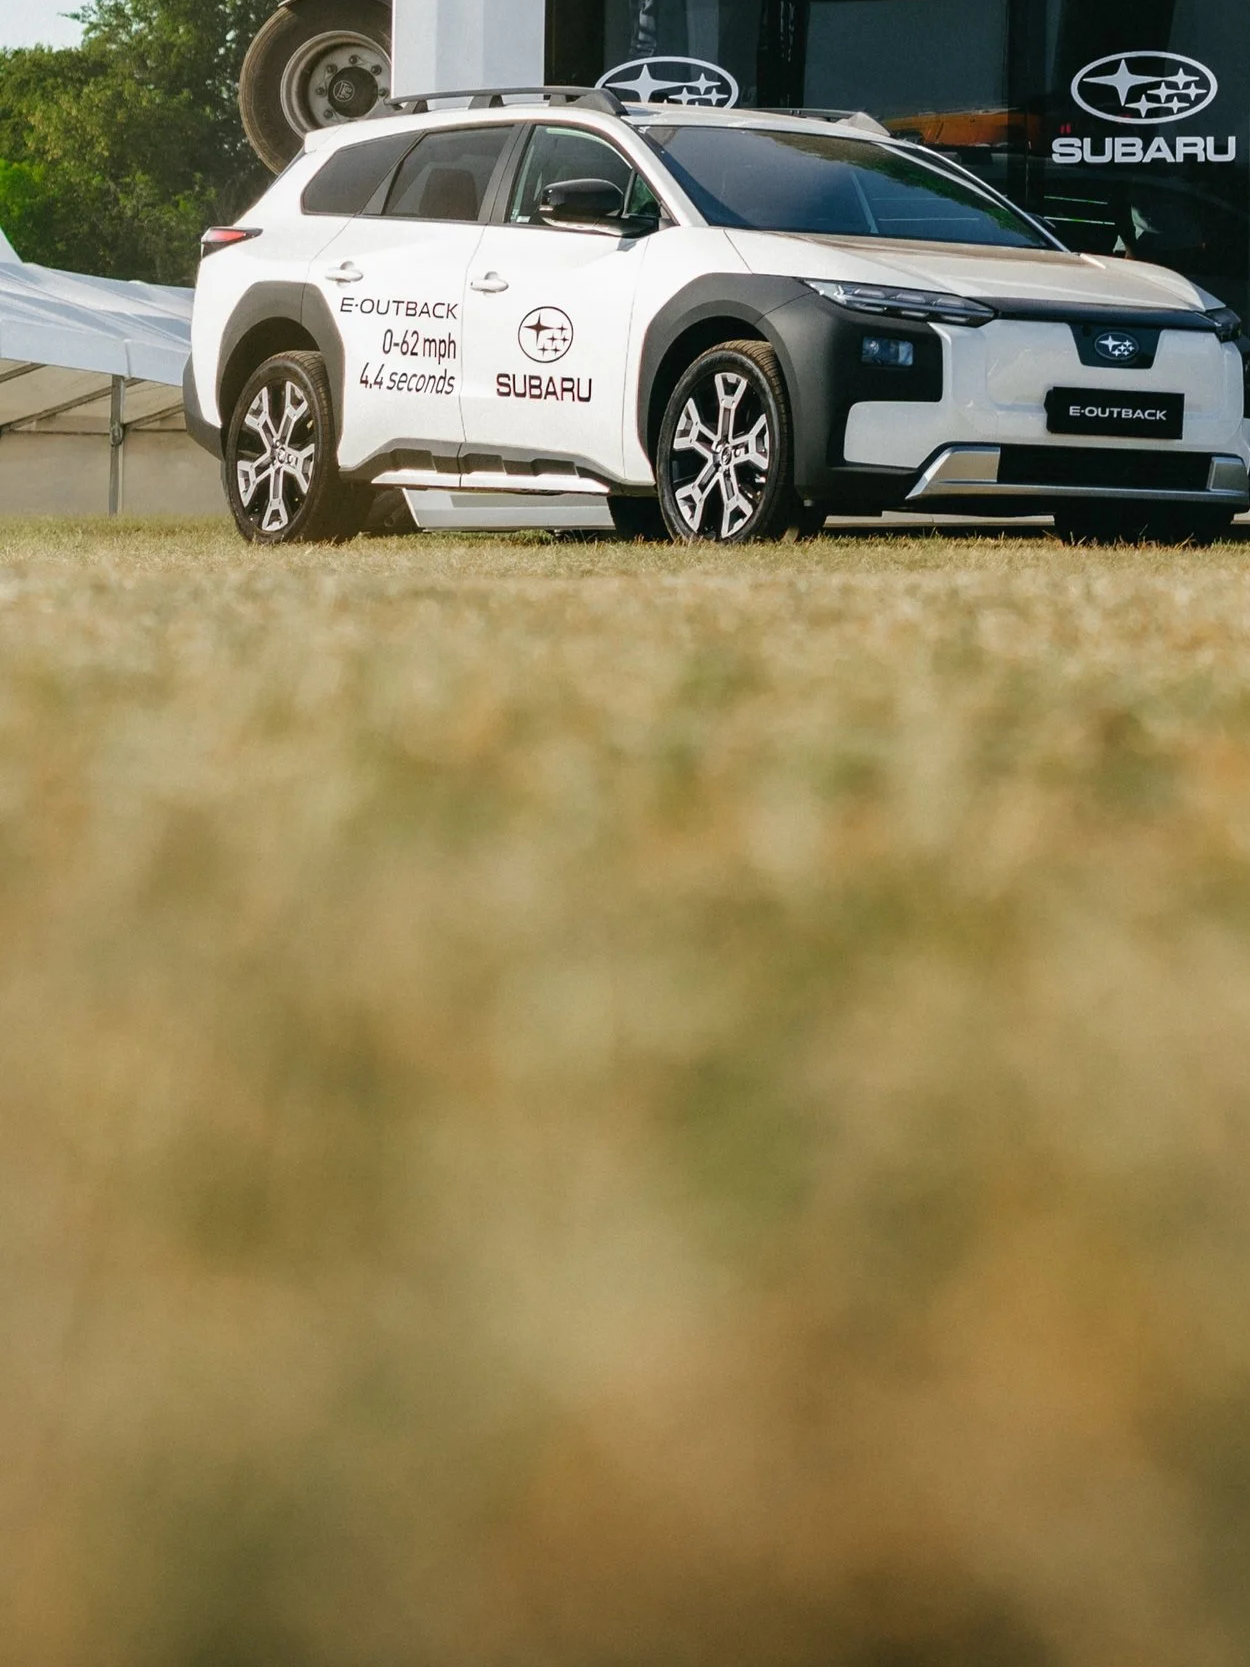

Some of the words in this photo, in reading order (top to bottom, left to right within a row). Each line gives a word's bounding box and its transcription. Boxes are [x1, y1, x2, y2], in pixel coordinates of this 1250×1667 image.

[1051, 135, 1237, 164] SUBARU
[340, 297, 458, 320] E-OUTBACK
[382, 328, 419, 357] 0-62
[422, 332, 457, 365] mph
[359, 362, 385, 390] 4.4
[386, 368, 456, 395] seconds
[496, 373, 592, 403] SUBARU
[1068, 405, 1168, 421] E-OUTBACK
